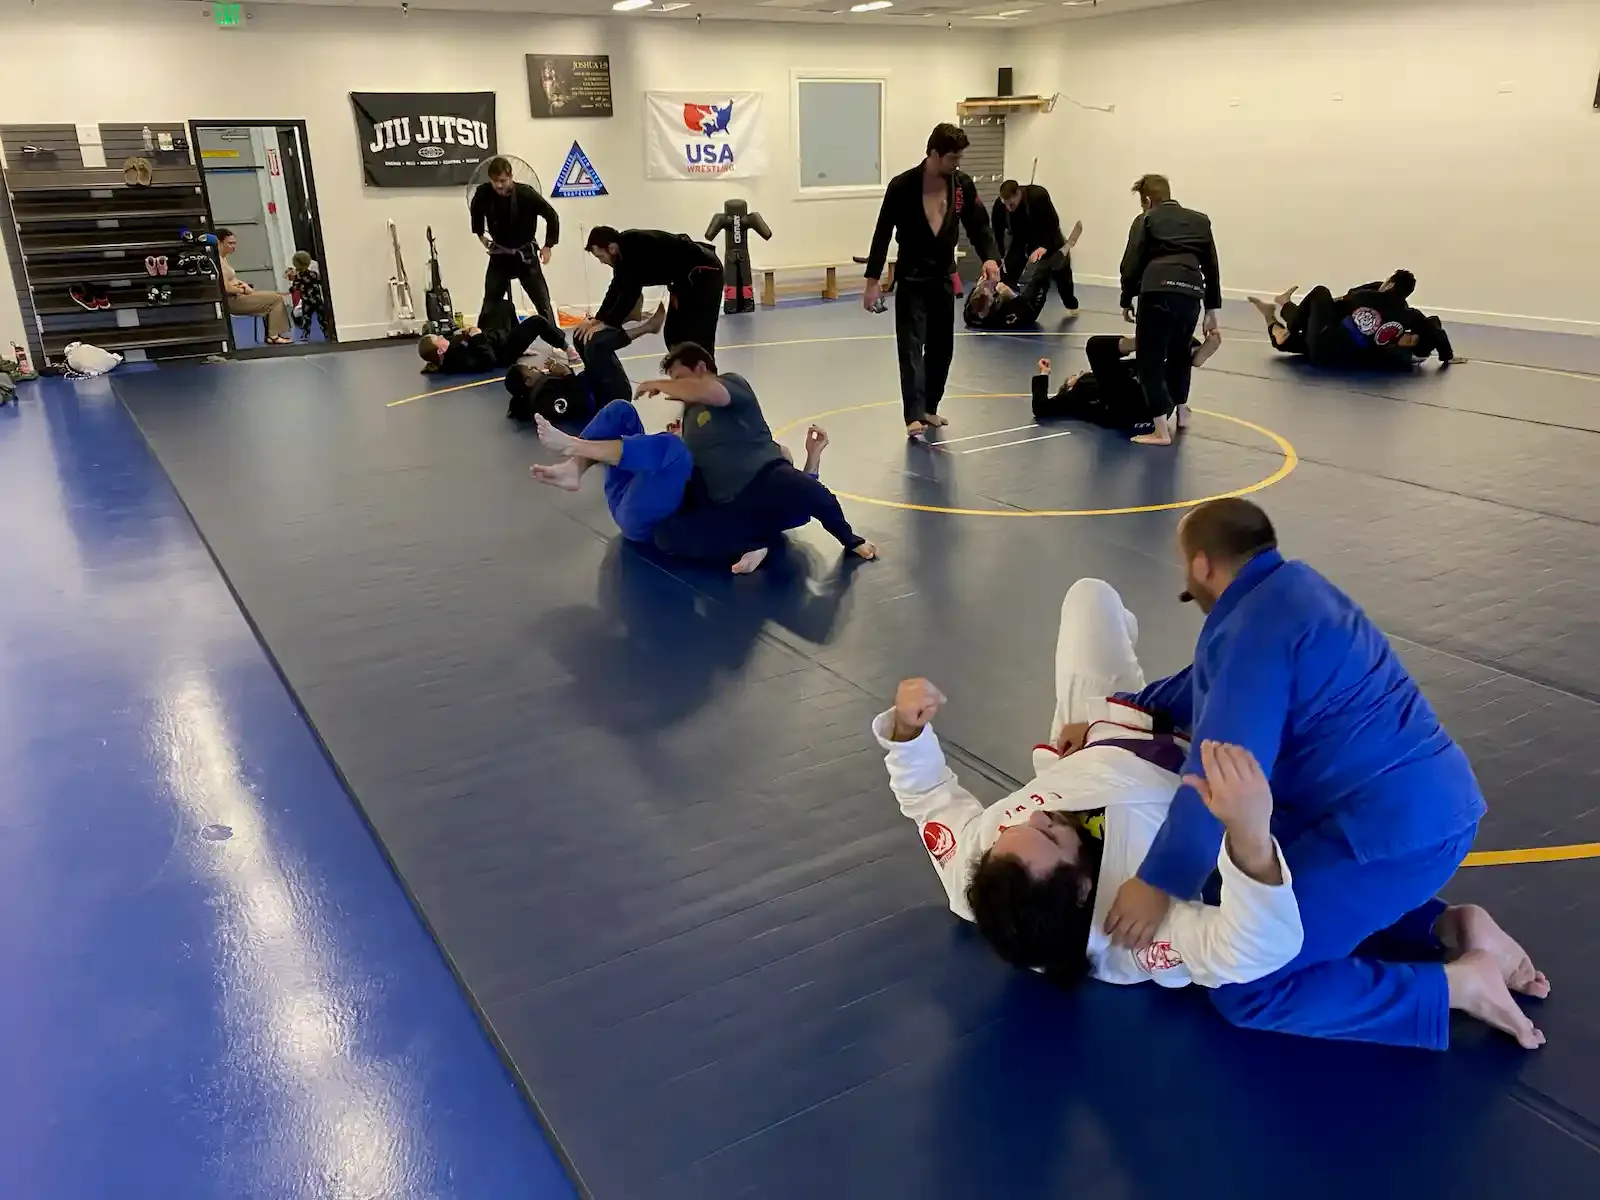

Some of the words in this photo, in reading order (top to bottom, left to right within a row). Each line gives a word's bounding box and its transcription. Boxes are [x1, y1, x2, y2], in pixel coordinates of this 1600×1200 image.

[572, 61, 599, 70] JOSHUA
[370, 119, 411, 153] JIU
[415, 116, 488, 149] JITSU
[686, 144, 734, 163] USA
[687, 164, 735, 173] WRESTLING
[733, 215, 741, 243] CENTURY
